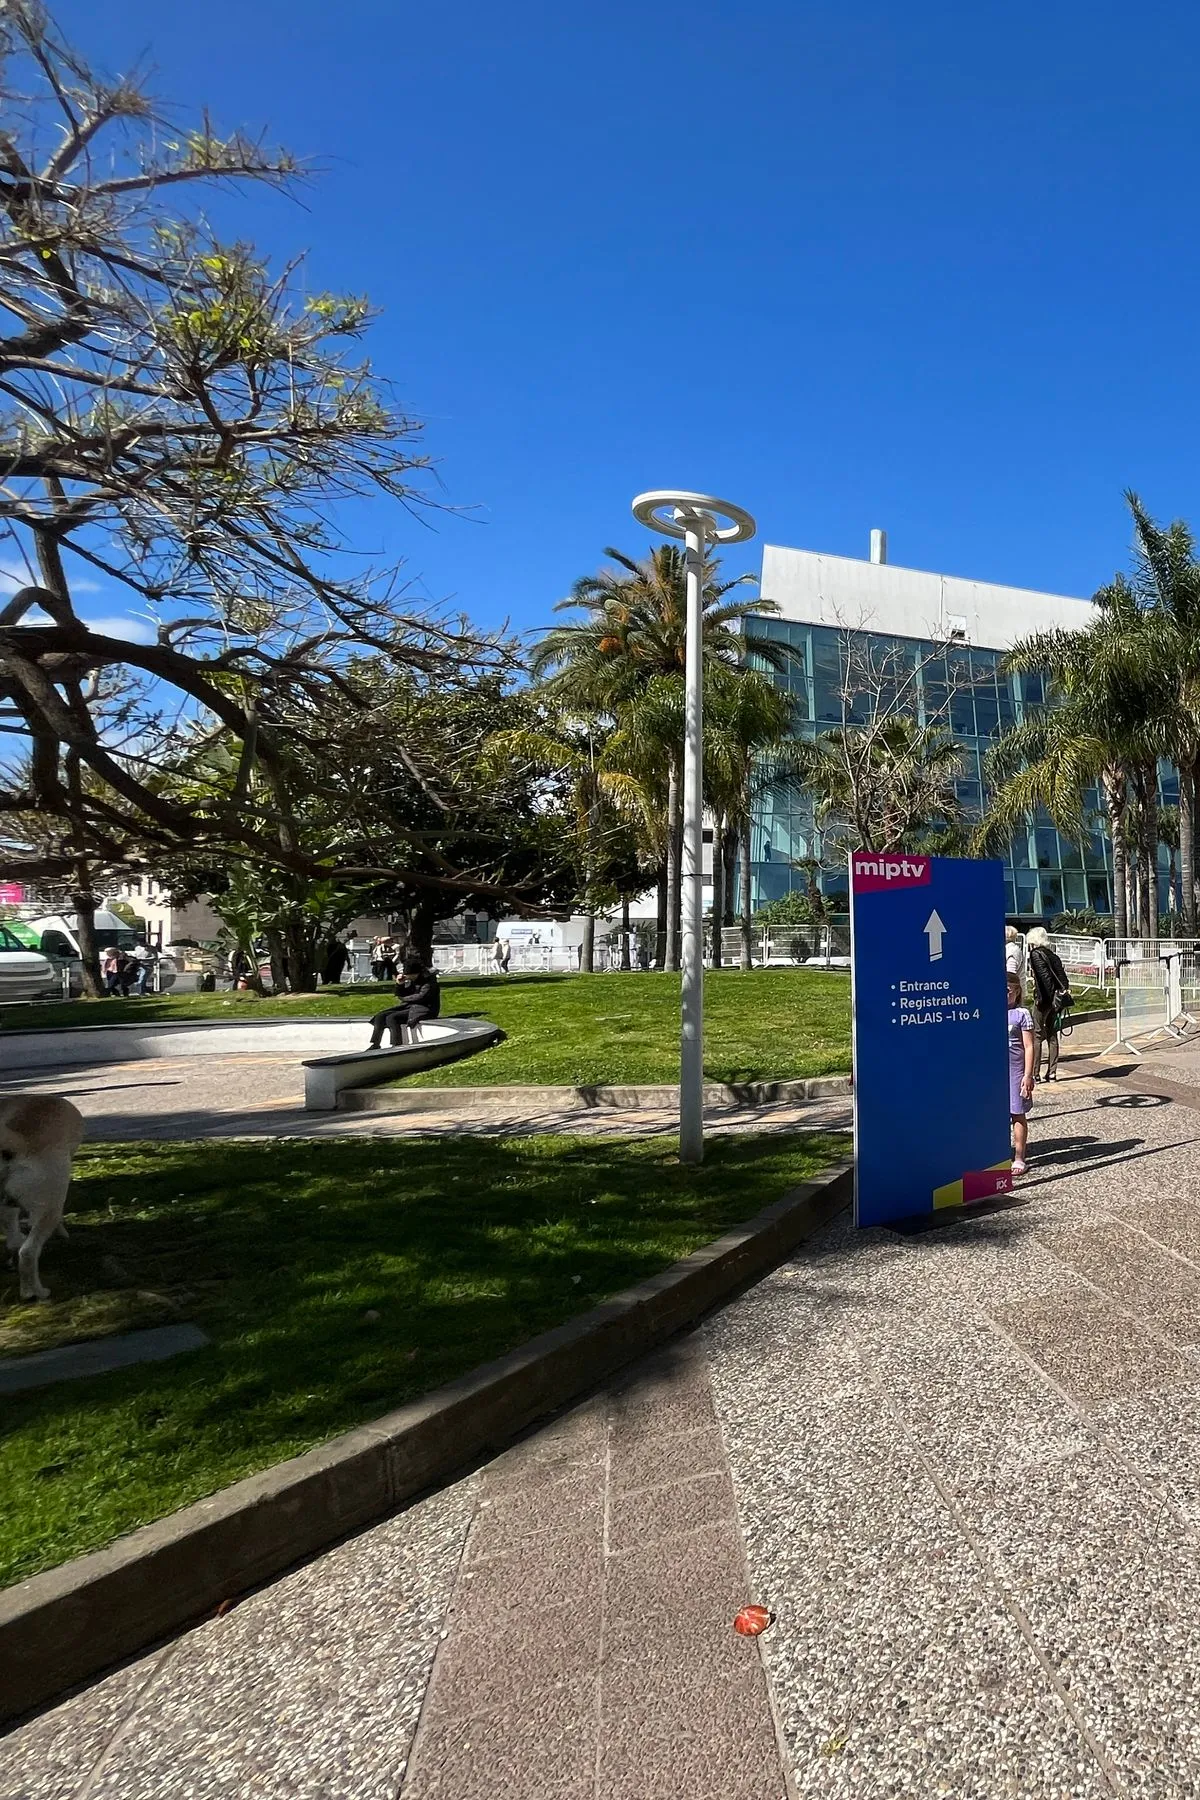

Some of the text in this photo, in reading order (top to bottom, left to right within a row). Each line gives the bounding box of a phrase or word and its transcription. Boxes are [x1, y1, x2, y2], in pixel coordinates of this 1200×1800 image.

[855, 858, 925, 880] miptv
[899, 980, 950, 992] Entrance
[900, 994, 968, 1010] Registration
[900, 1012, 943, 1026] PALAIS
[959, 1010, 970, 1020] to
[972, 1008, 980, 1019] 4
